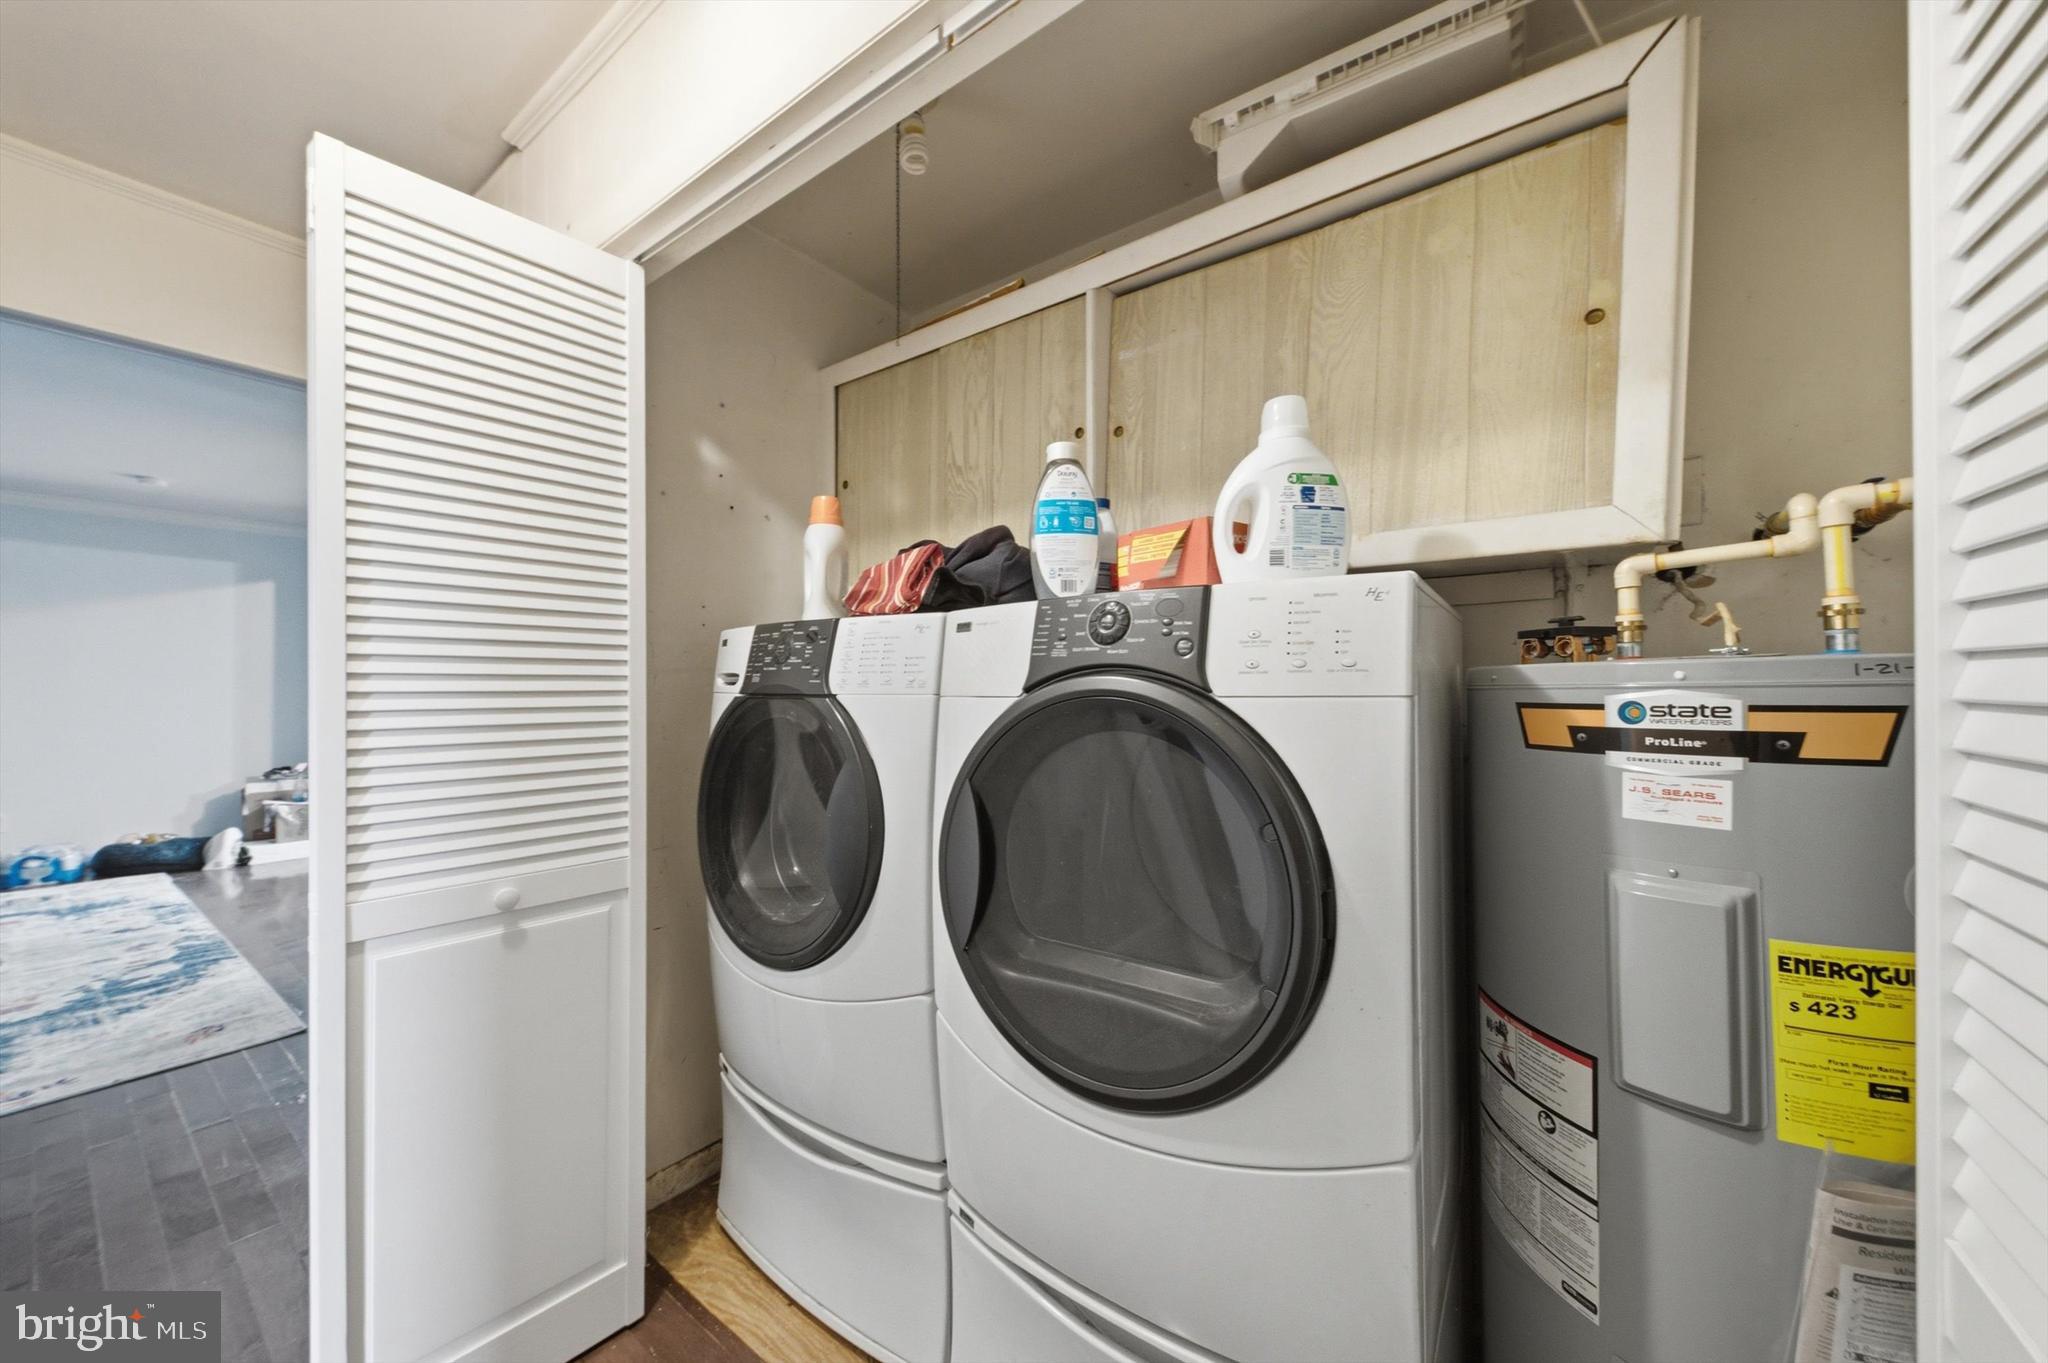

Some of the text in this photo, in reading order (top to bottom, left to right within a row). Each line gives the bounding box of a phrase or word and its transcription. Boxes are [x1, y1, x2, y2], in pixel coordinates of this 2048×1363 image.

[1649, 704, 1733, 719] state
[1684, 719, 1734, 727] HEATERS
[1626, 756, 1685, 765] COMMERCIAL
[1628, 785, 1717, 800] J.S. SEARS
[1807, 1001, 1858, 1021] 423
